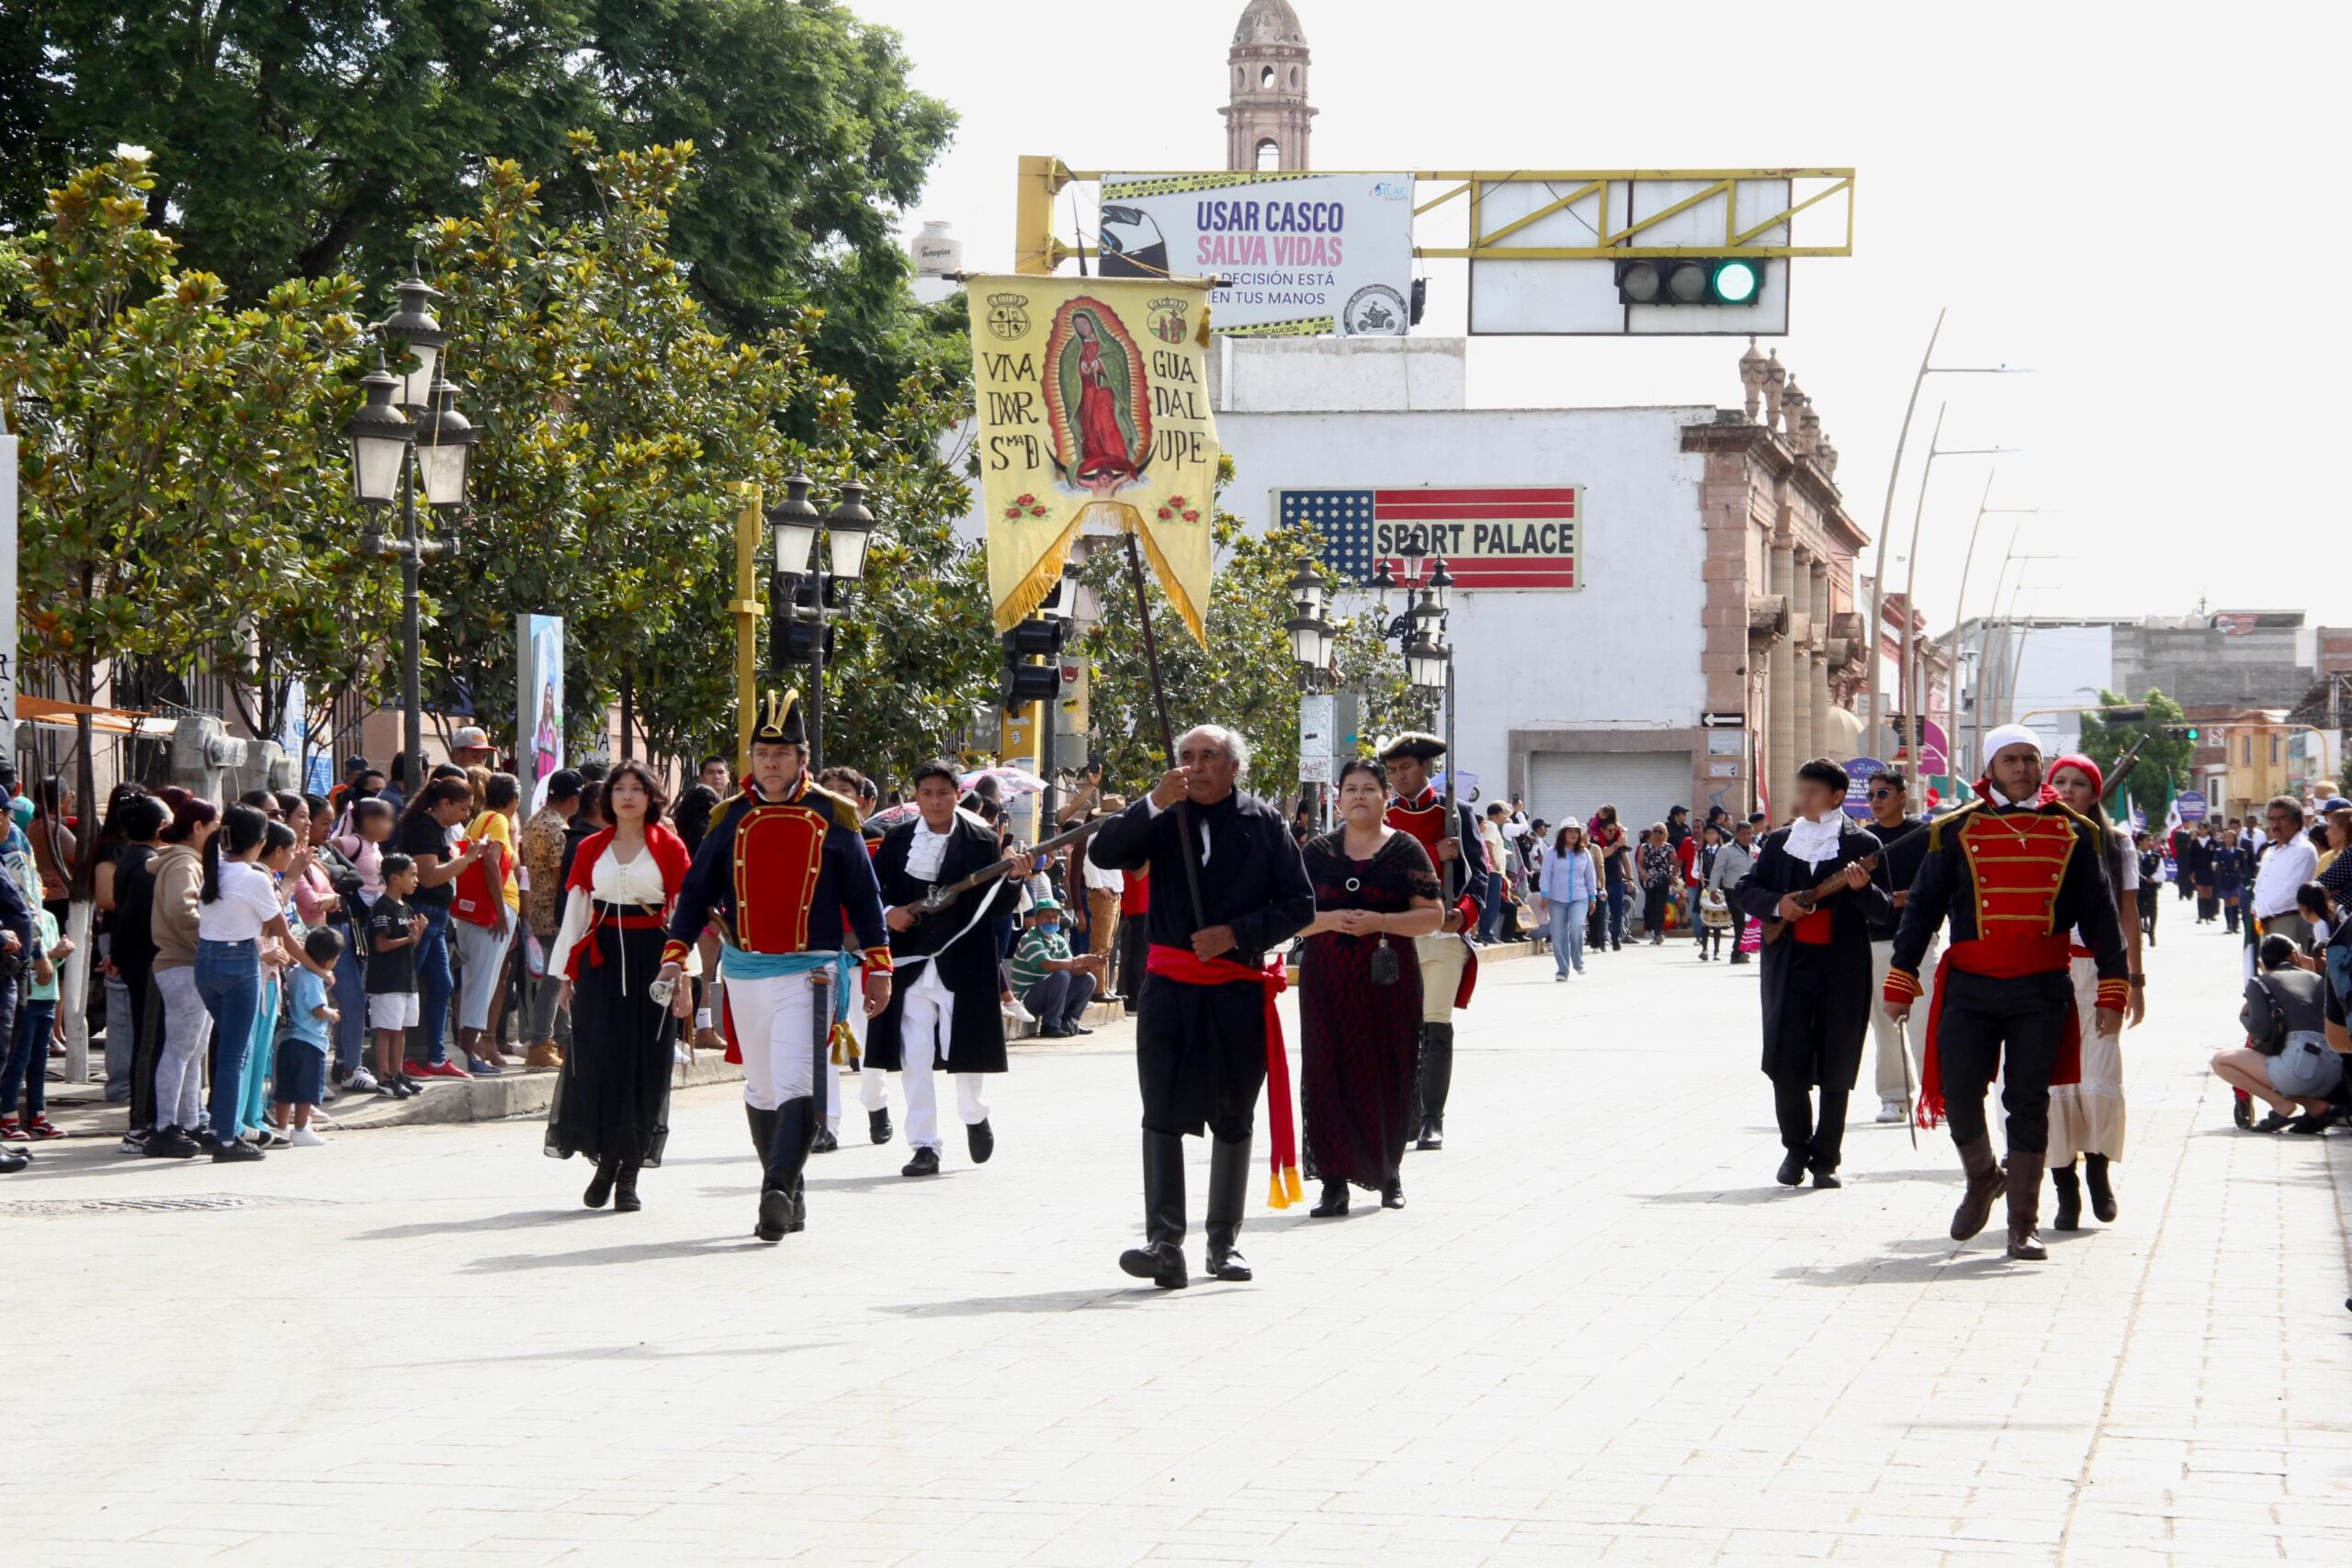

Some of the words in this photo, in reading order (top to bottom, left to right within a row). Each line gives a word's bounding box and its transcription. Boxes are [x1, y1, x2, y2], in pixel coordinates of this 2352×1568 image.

[1133, 183, 1177, 193] PRECAUCIÓN
[1192, 175, 1236, 186] PRECAUCIÓN
[1197, 201, 1260, 231] USAR
[1265, 201, 1343, 232] CASCO
[1197, 235, 1267, 265] SALVA
[1273, 236, 1342, 266] VIDAS
[1222, 271, 1293, 286] DECISIÓN
[1298, 271, 1335, 286] ESTÁ
[1212, 291, 1229, 303] EN
[1235, 292, 1262, 304] TUS
[1269, 292, 1325, 305] MANOS
[982, 353, 1036, 382] VIVA
[1153, 350, 1198, 383] GUA
[1154, 386, 1206, 420] DAL
[1159, 430, 1206, 470] UPE
[1474, 524, 1574, 554] PALACE
